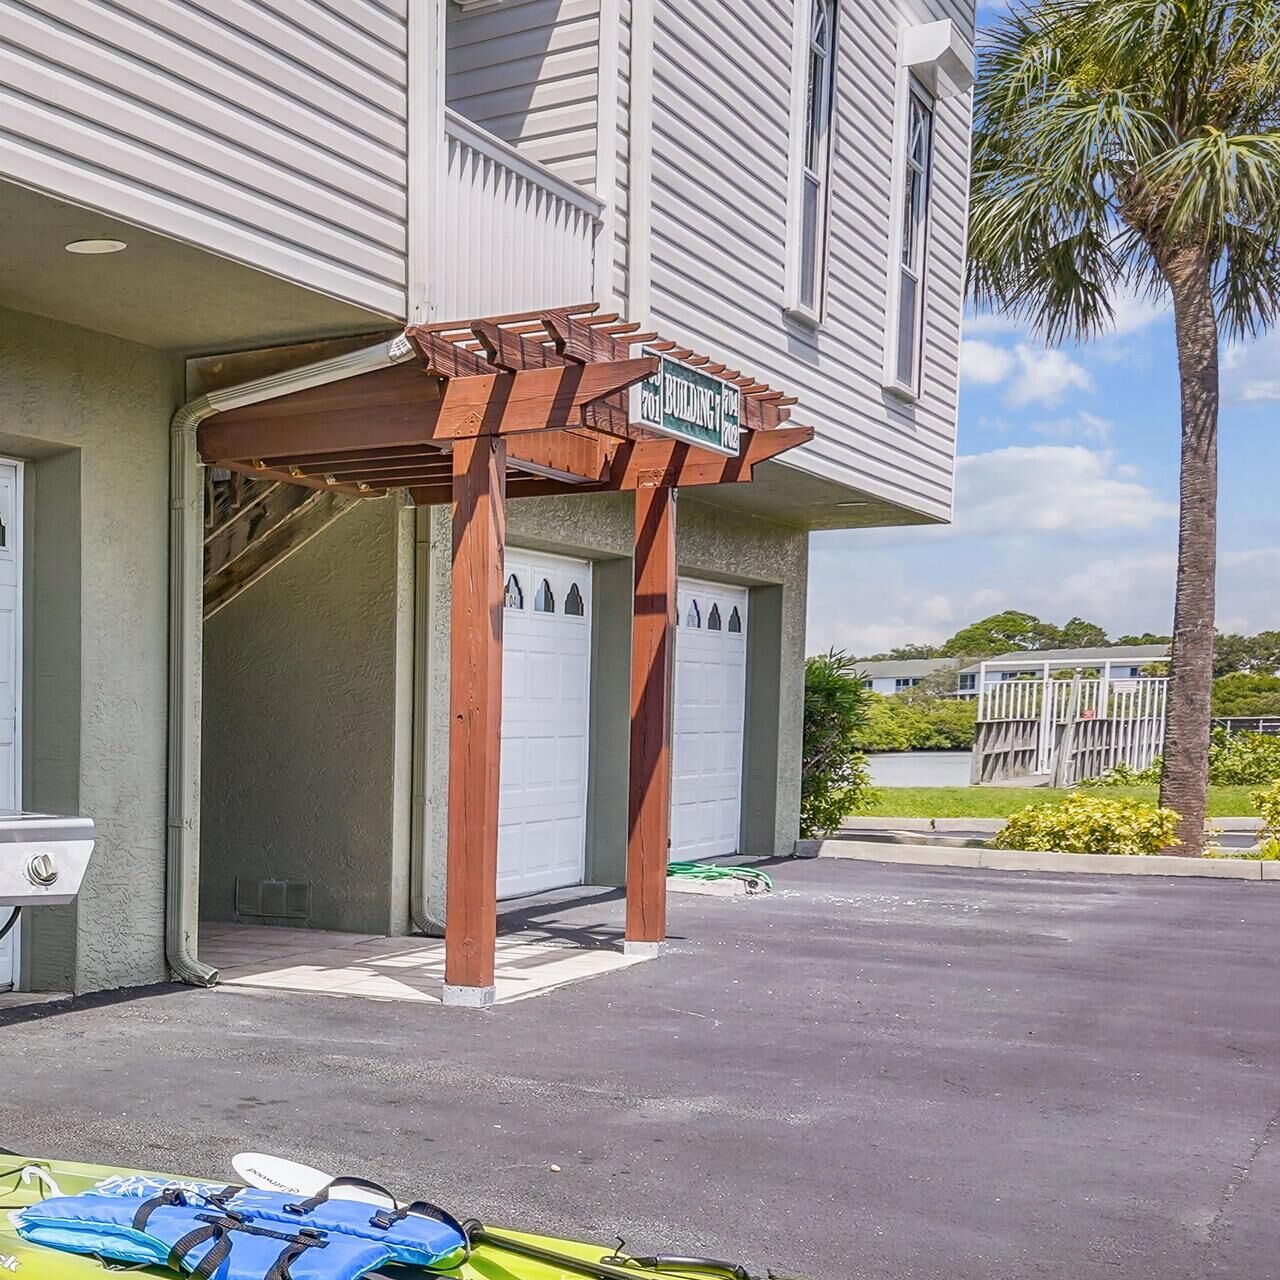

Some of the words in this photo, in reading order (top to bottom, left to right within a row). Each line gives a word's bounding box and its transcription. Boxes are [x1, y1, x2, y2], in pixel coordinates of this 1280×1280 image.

[642, 389, 661, 422] 701
[664, 373, 715, 430] BUILDING
[714, 394, 721, 432] 7
